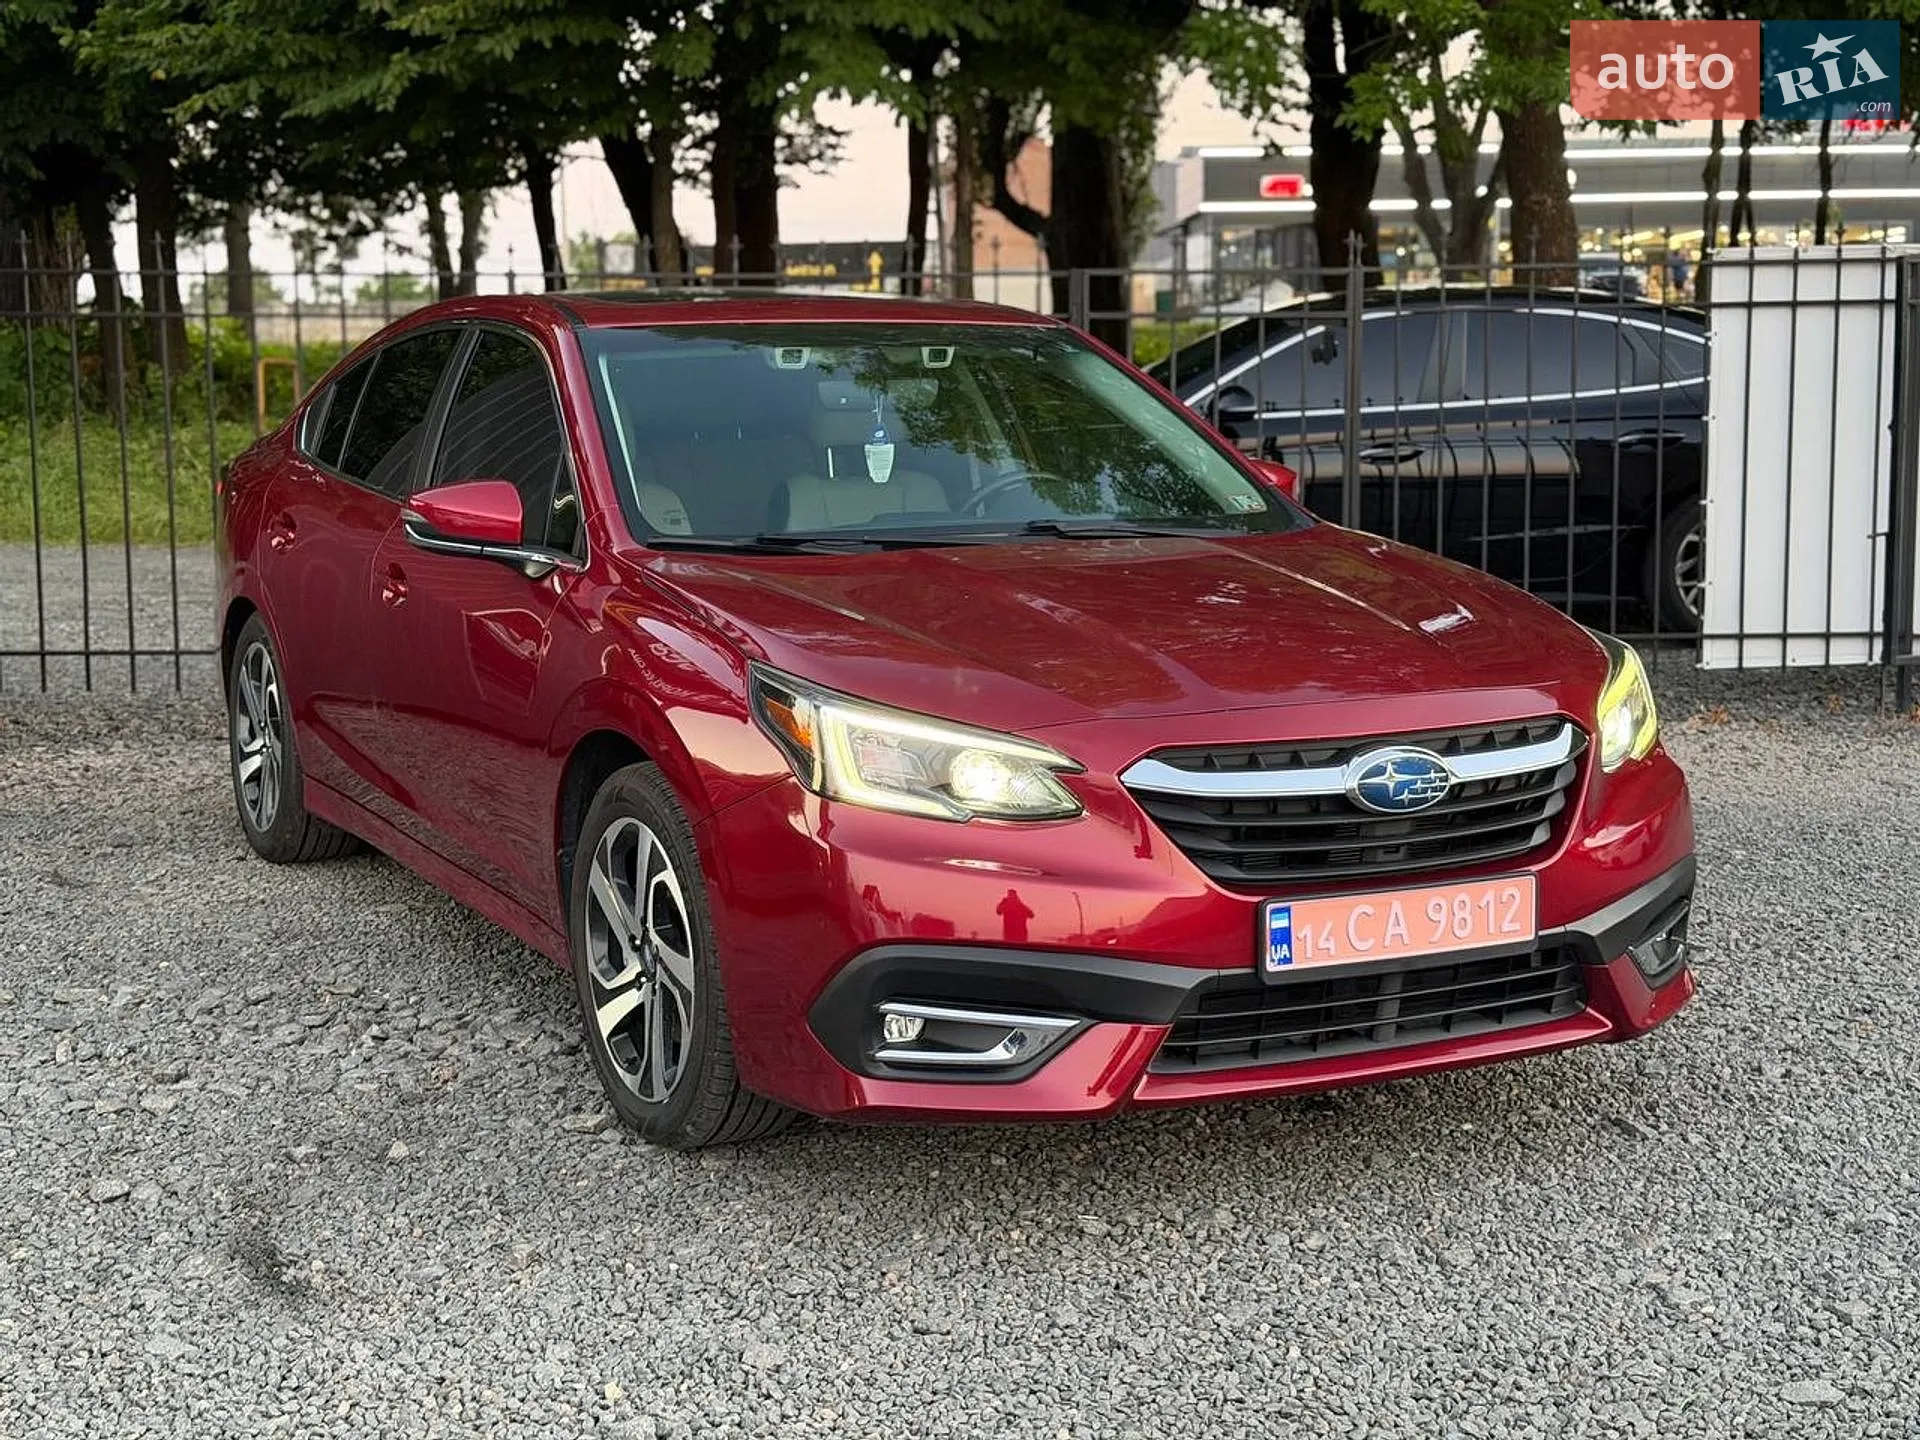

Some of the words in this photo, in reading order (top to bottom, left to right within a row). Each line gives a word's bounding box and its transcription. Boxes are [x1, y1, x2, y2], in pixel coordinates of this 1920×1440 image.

[1296, 921, 1337, 959] 14
[1347, 902, 1411, 951] CA
[1425, 886, 1522, 945] 9812
[1271, 943, 1290, 960] UA
